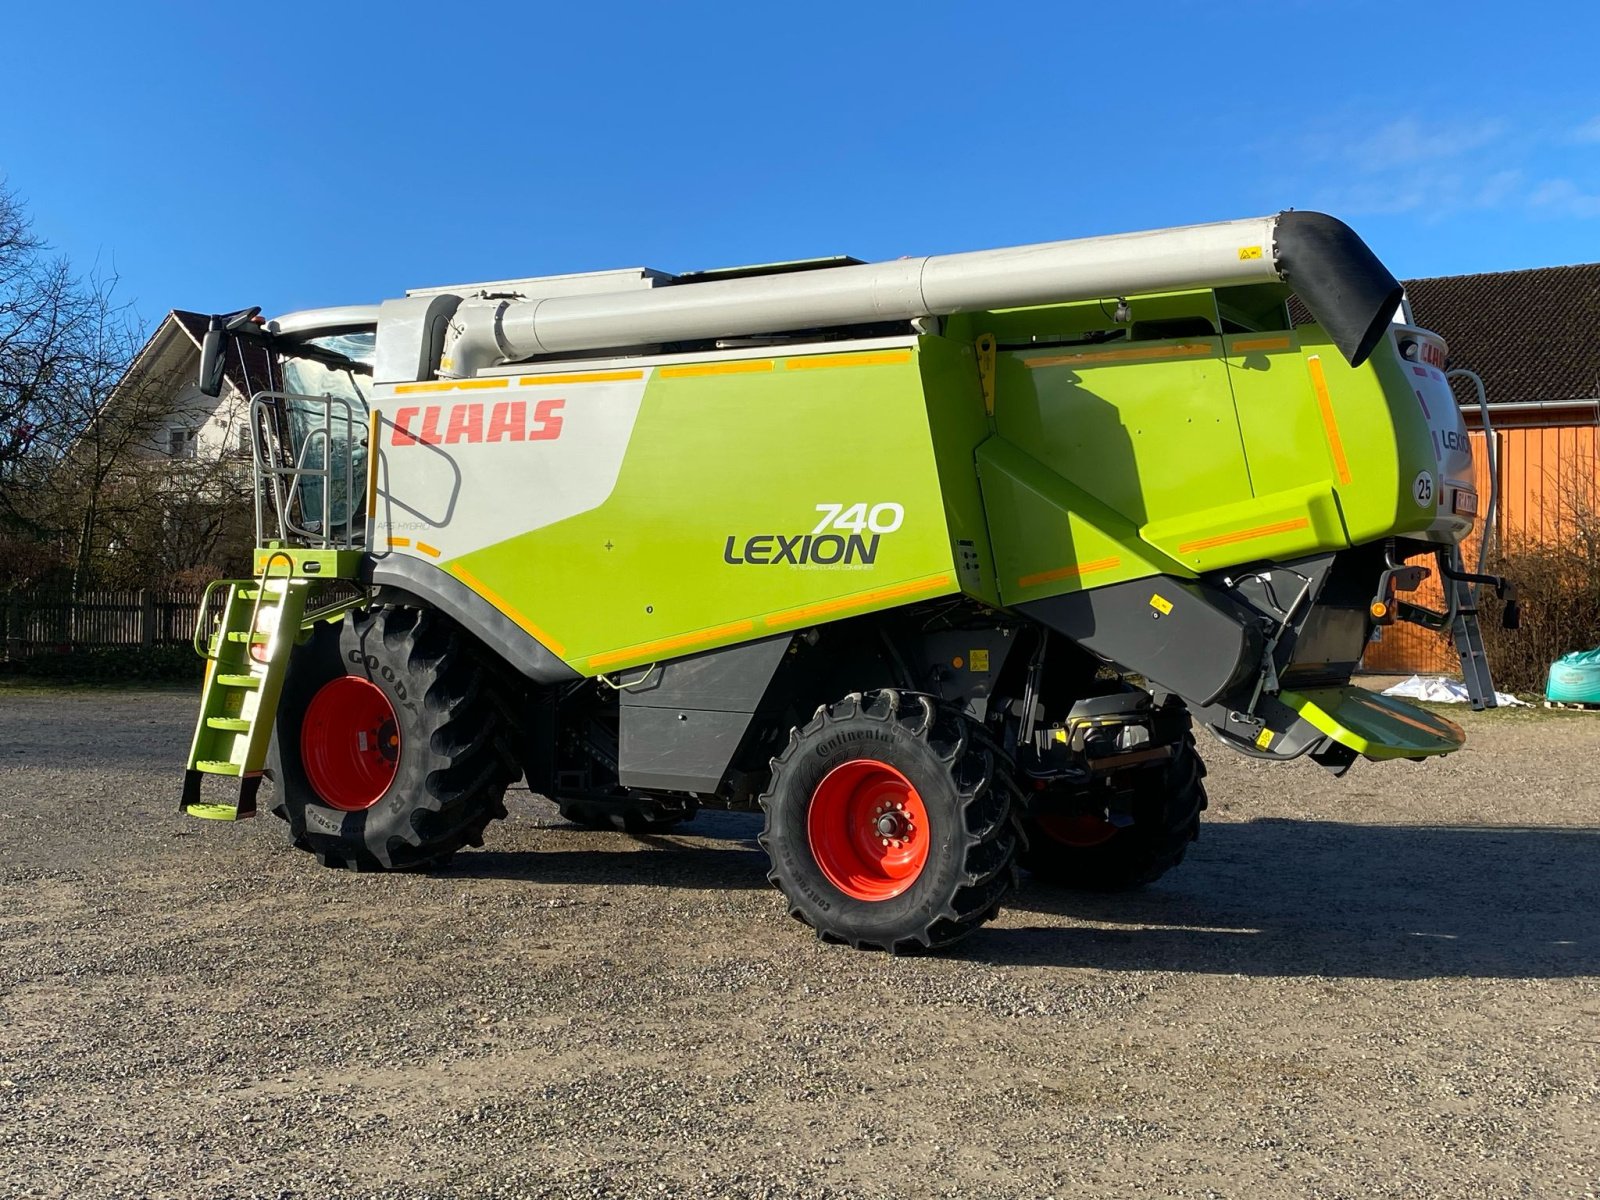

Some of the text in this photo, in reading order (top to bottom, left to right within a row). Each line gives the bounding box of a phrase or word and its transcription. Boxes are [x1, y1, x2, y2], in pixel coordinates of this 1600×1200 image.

[391, 399, 565, 446] CLAAS
[1418, 478, 1431, 500] 25
[811, 502, 905, 534] 740
[724, 534, 880, 565] LEXION
[815, 728, 896, 758] Continental
